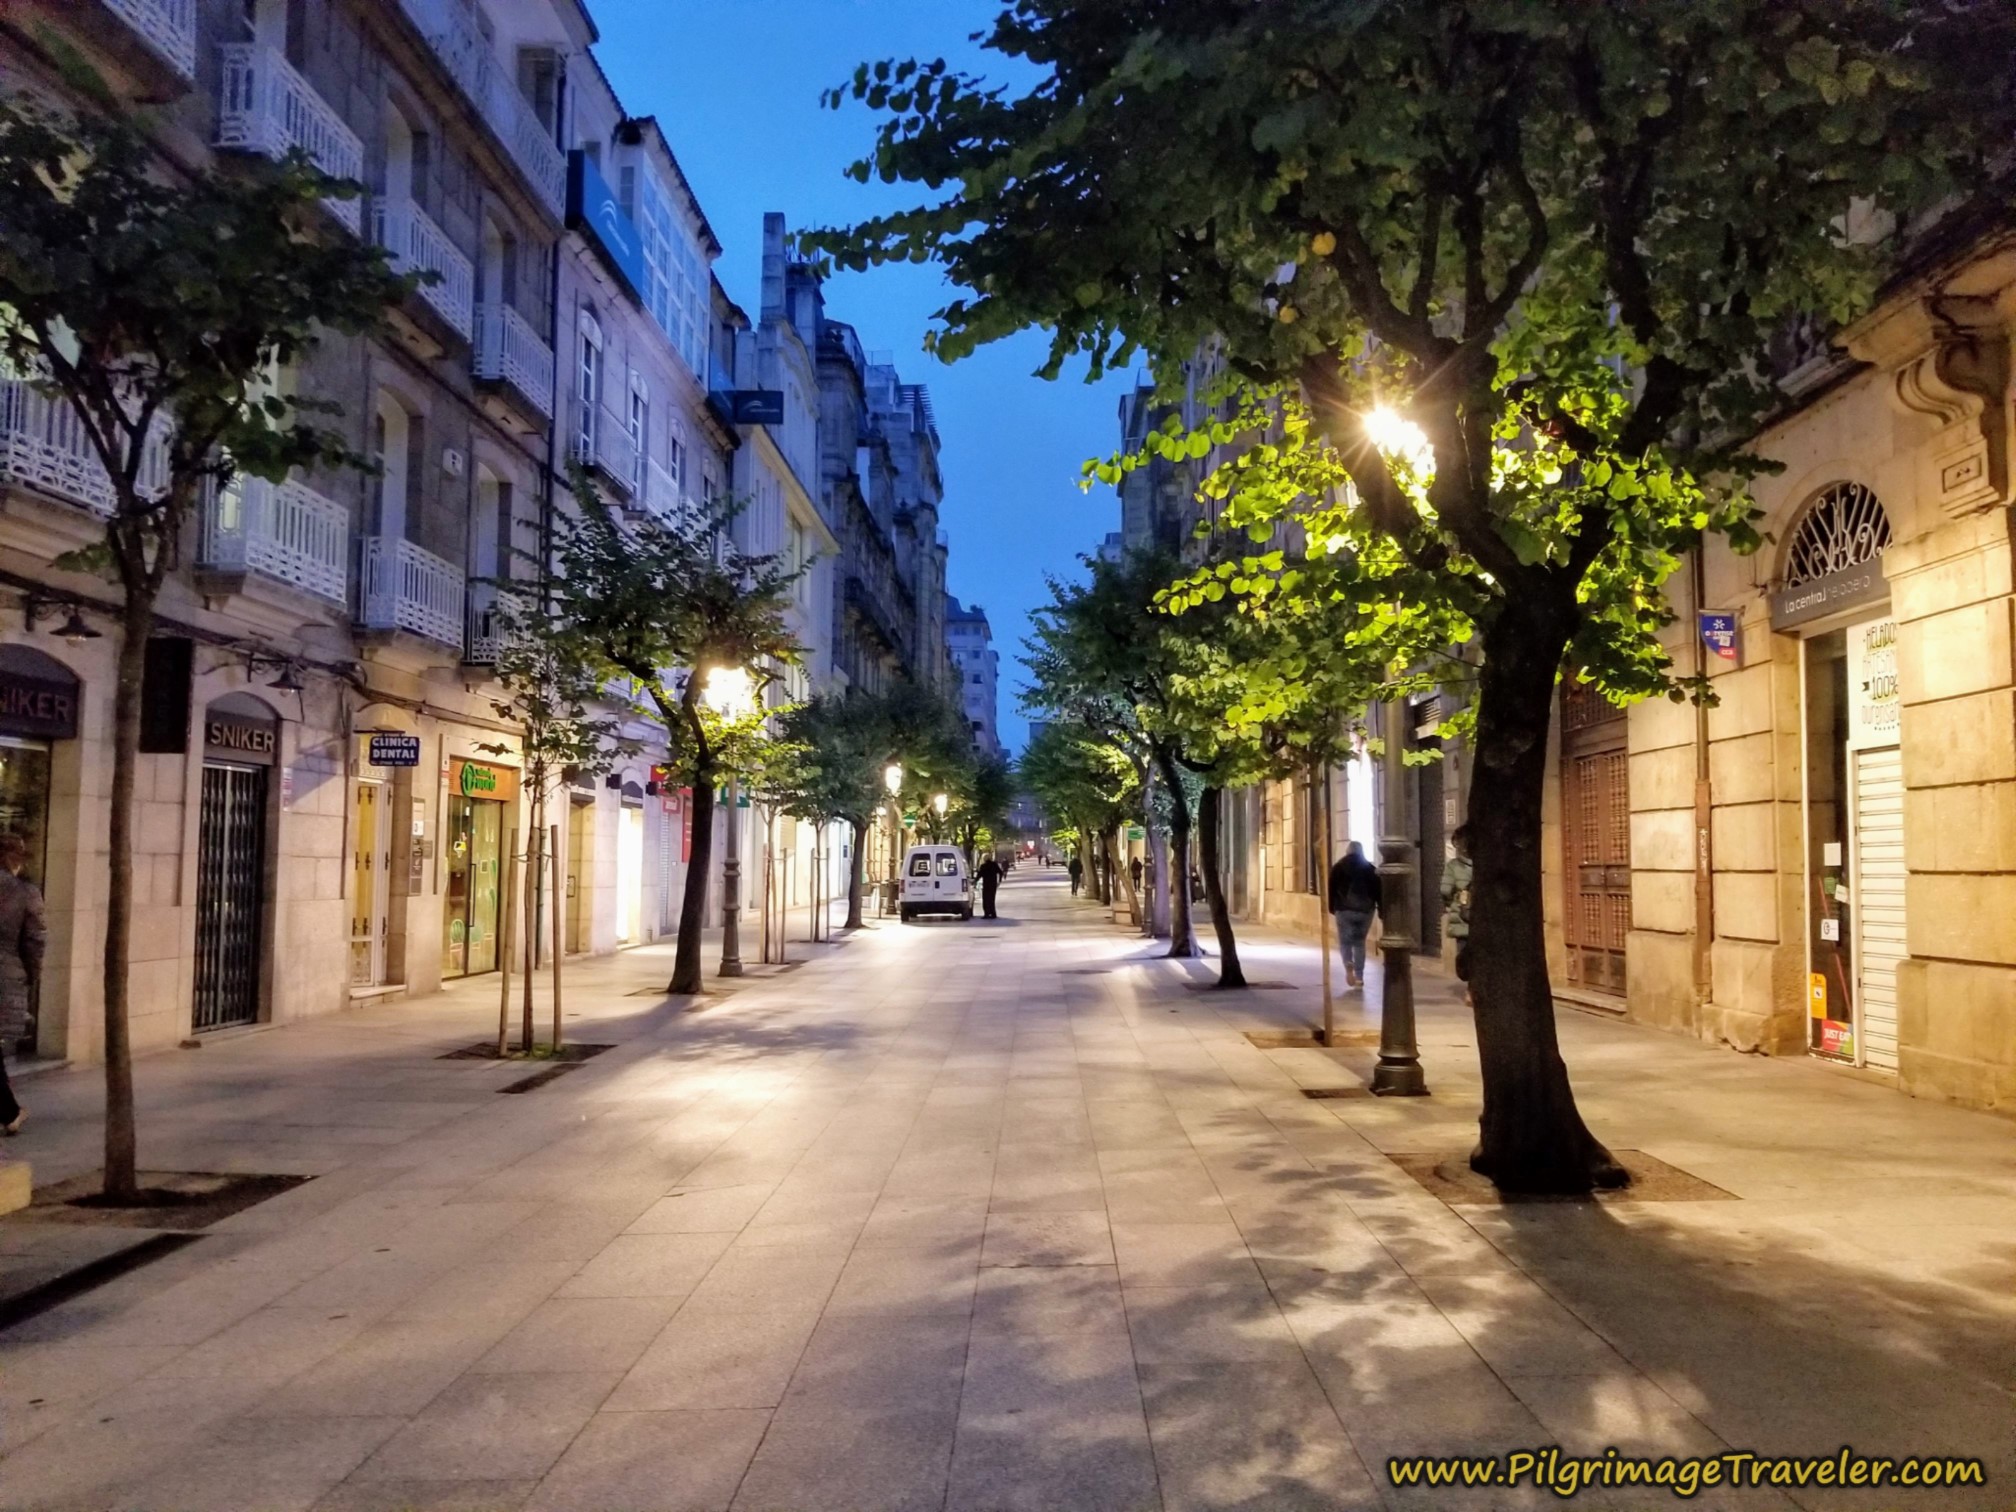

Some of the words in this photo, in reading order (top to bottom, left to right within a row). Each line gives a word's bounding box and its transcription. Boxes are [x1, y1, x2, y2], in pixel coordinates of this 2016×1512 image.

[1872, 674, 1899, 701] 100%
[211, 722, 275, 752] SNIKER
[372, 737, 417, 747] CLINICA
[373, 749, 415, 759] DENTAL
